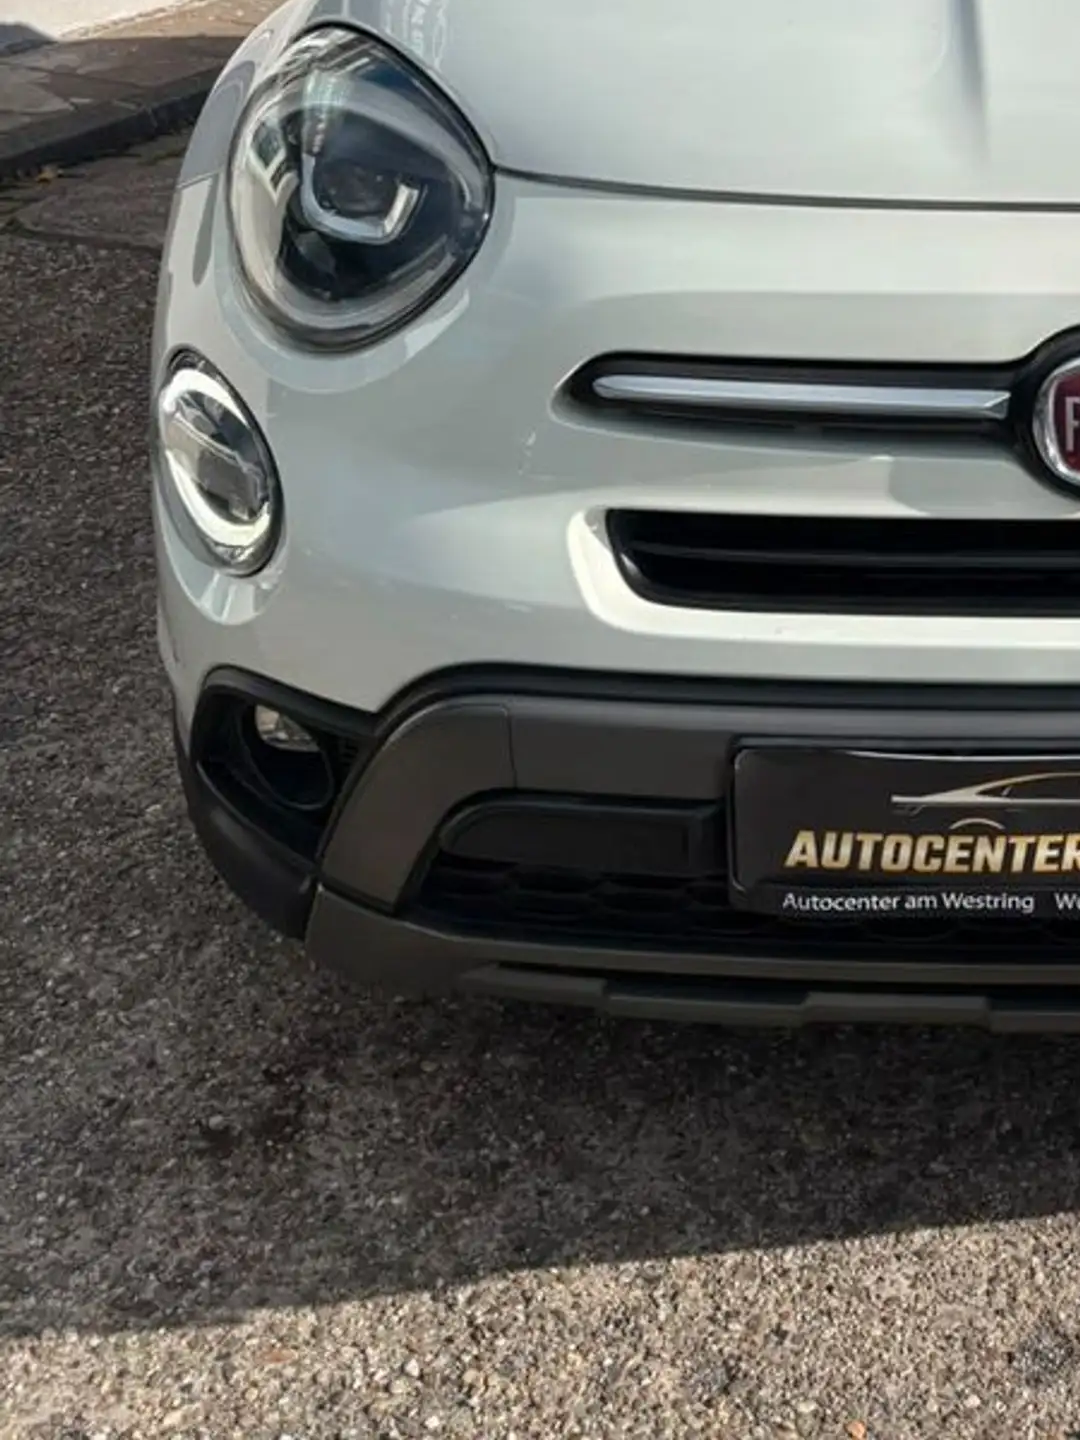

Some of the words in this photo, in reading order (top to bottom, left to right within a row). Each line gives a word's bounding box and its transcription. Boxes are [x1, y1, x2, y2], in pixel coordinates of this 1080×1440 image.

[783, 892, 901, 911] Autocenter
[904, 895, 938, 910] am
[941, 892, 1035, 915] Westring
